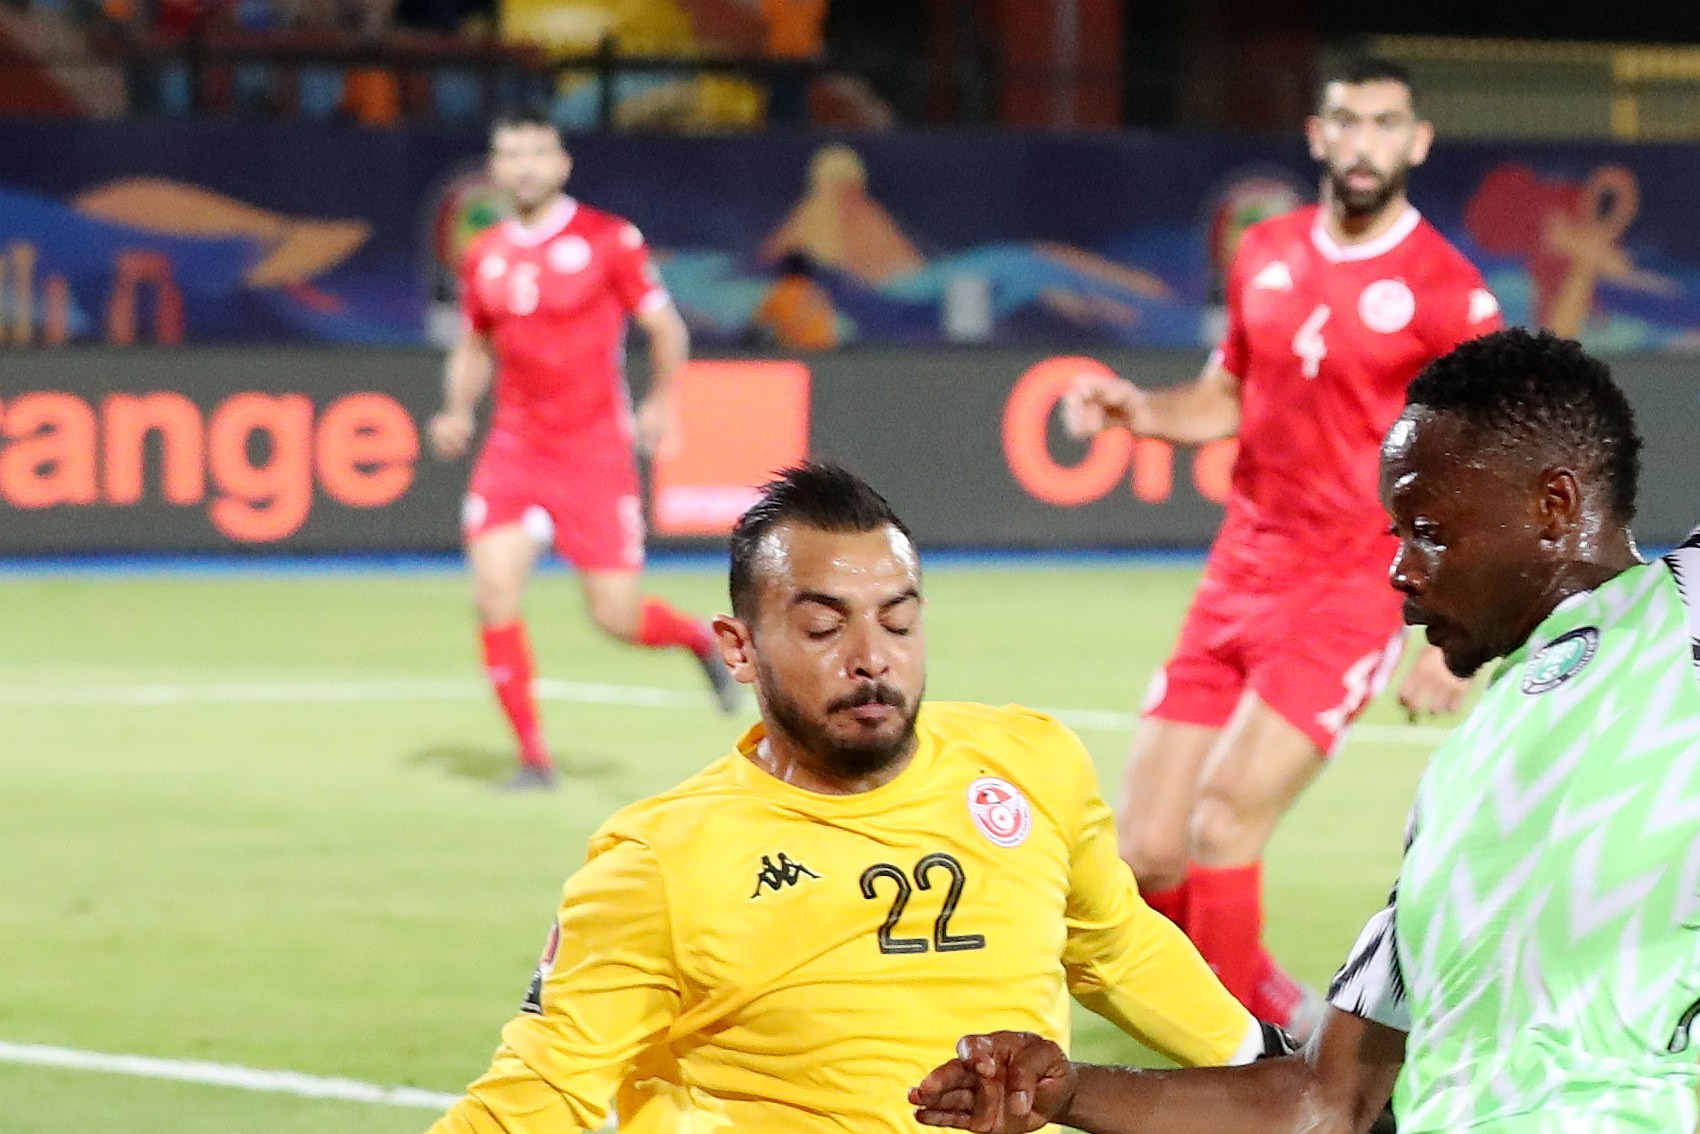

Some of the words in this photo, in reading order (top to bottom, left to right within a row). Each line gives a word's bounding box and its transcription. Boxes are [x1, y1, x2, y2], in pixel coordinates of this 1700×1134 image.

[1291, 303, 1332, 381] 4
[0, 390, 421, 544] ange
[859, 852, 986, 955] 22
